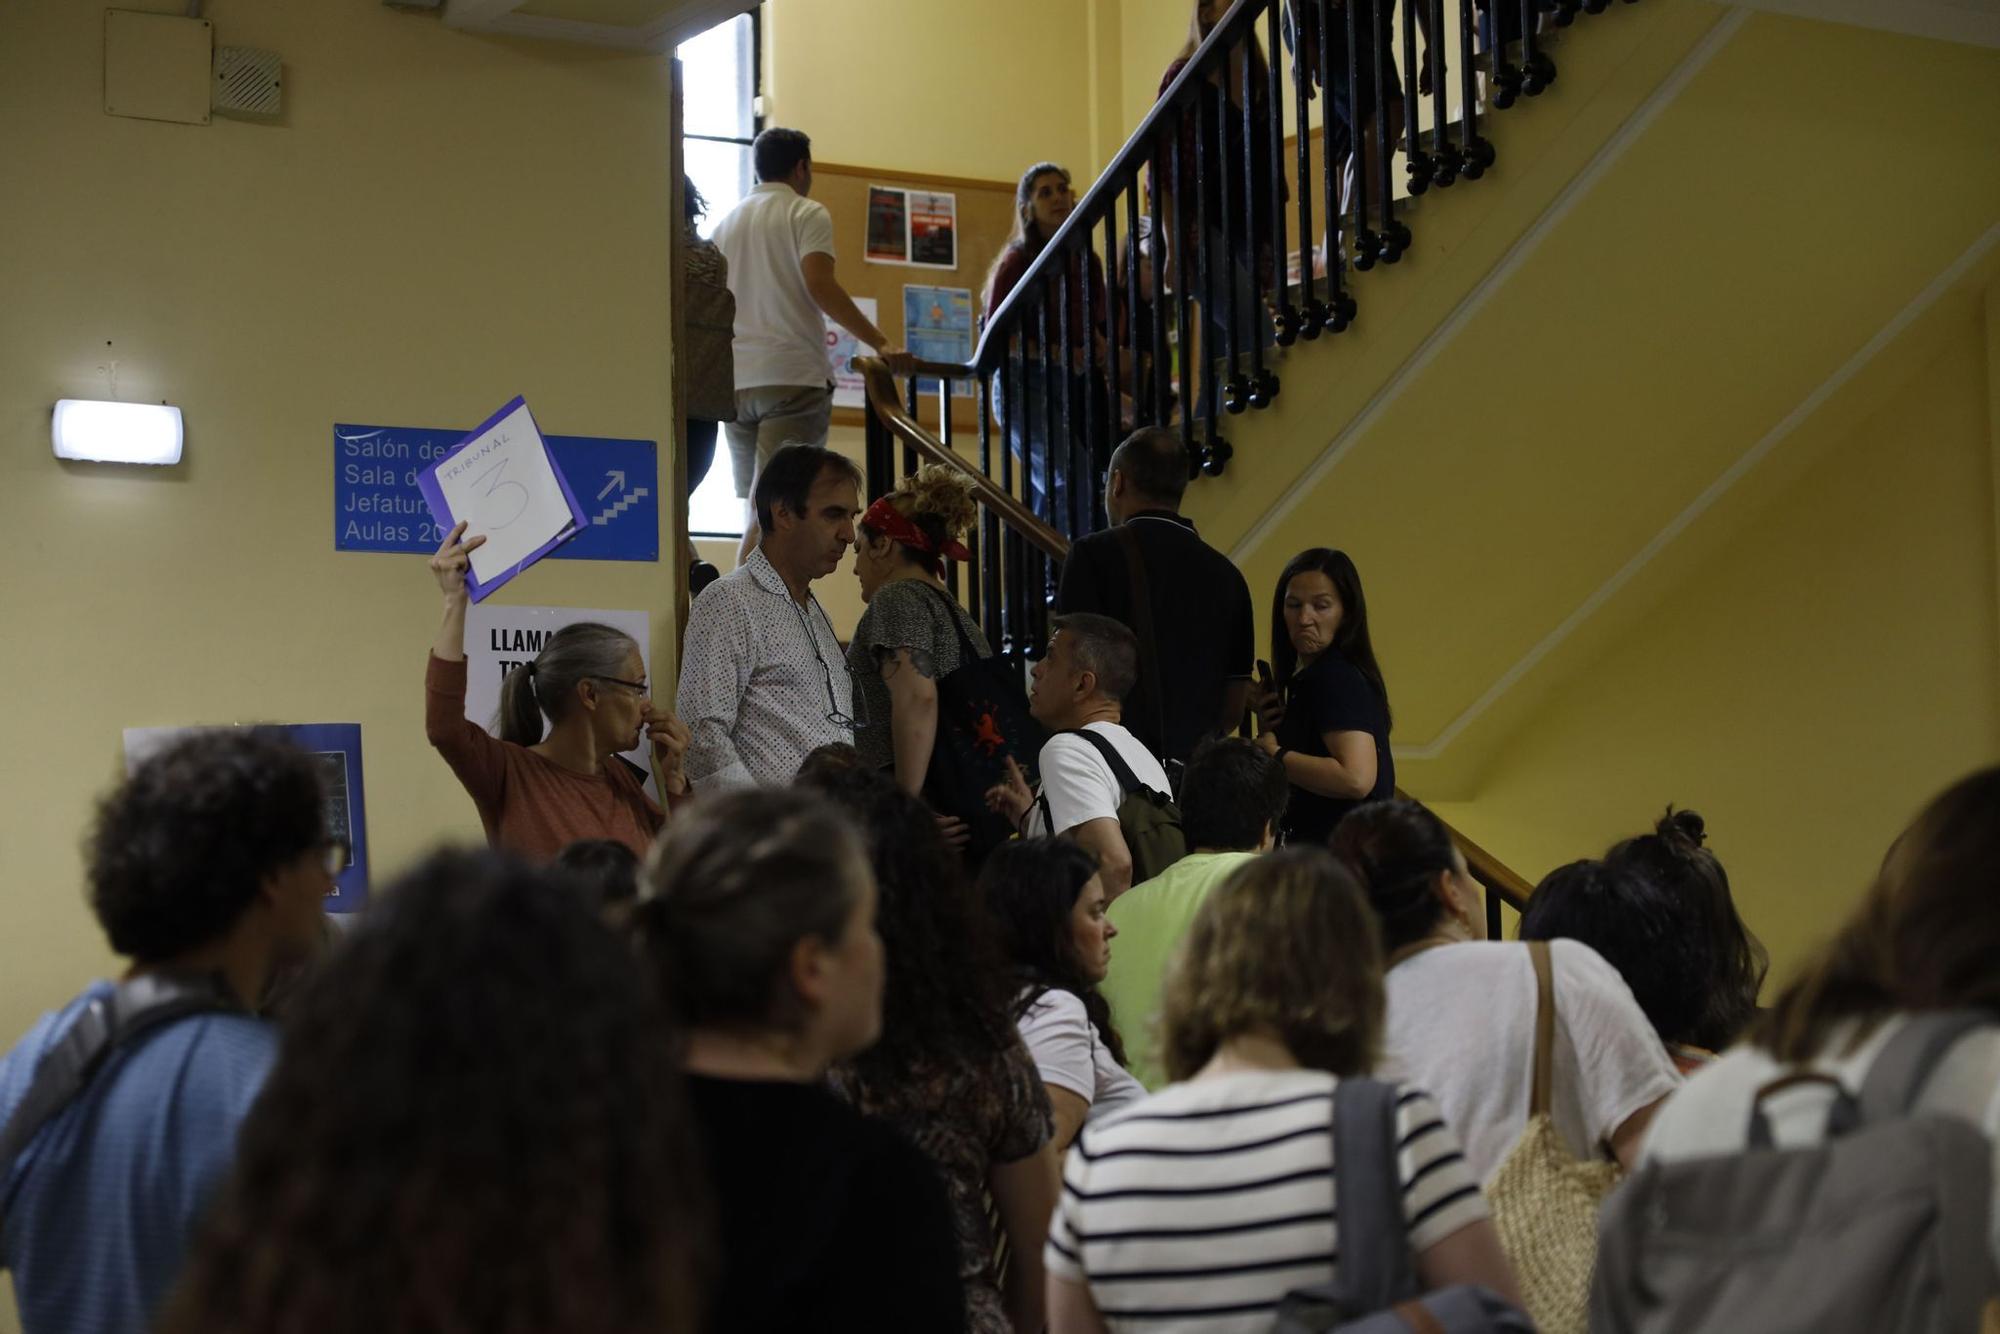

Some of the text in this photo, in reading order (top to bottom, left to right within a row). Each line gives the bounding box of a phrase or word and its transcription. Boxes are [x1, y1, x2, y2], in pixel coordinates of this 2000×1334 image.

[345, 438, 446, 460] Salón de
[445, 433, 511, 480] TRIBUNAL
[345, 464, 417, 487] Sala d
[470, 457, 529, 531] 3
[344, 519, 409, 541] Aulas
